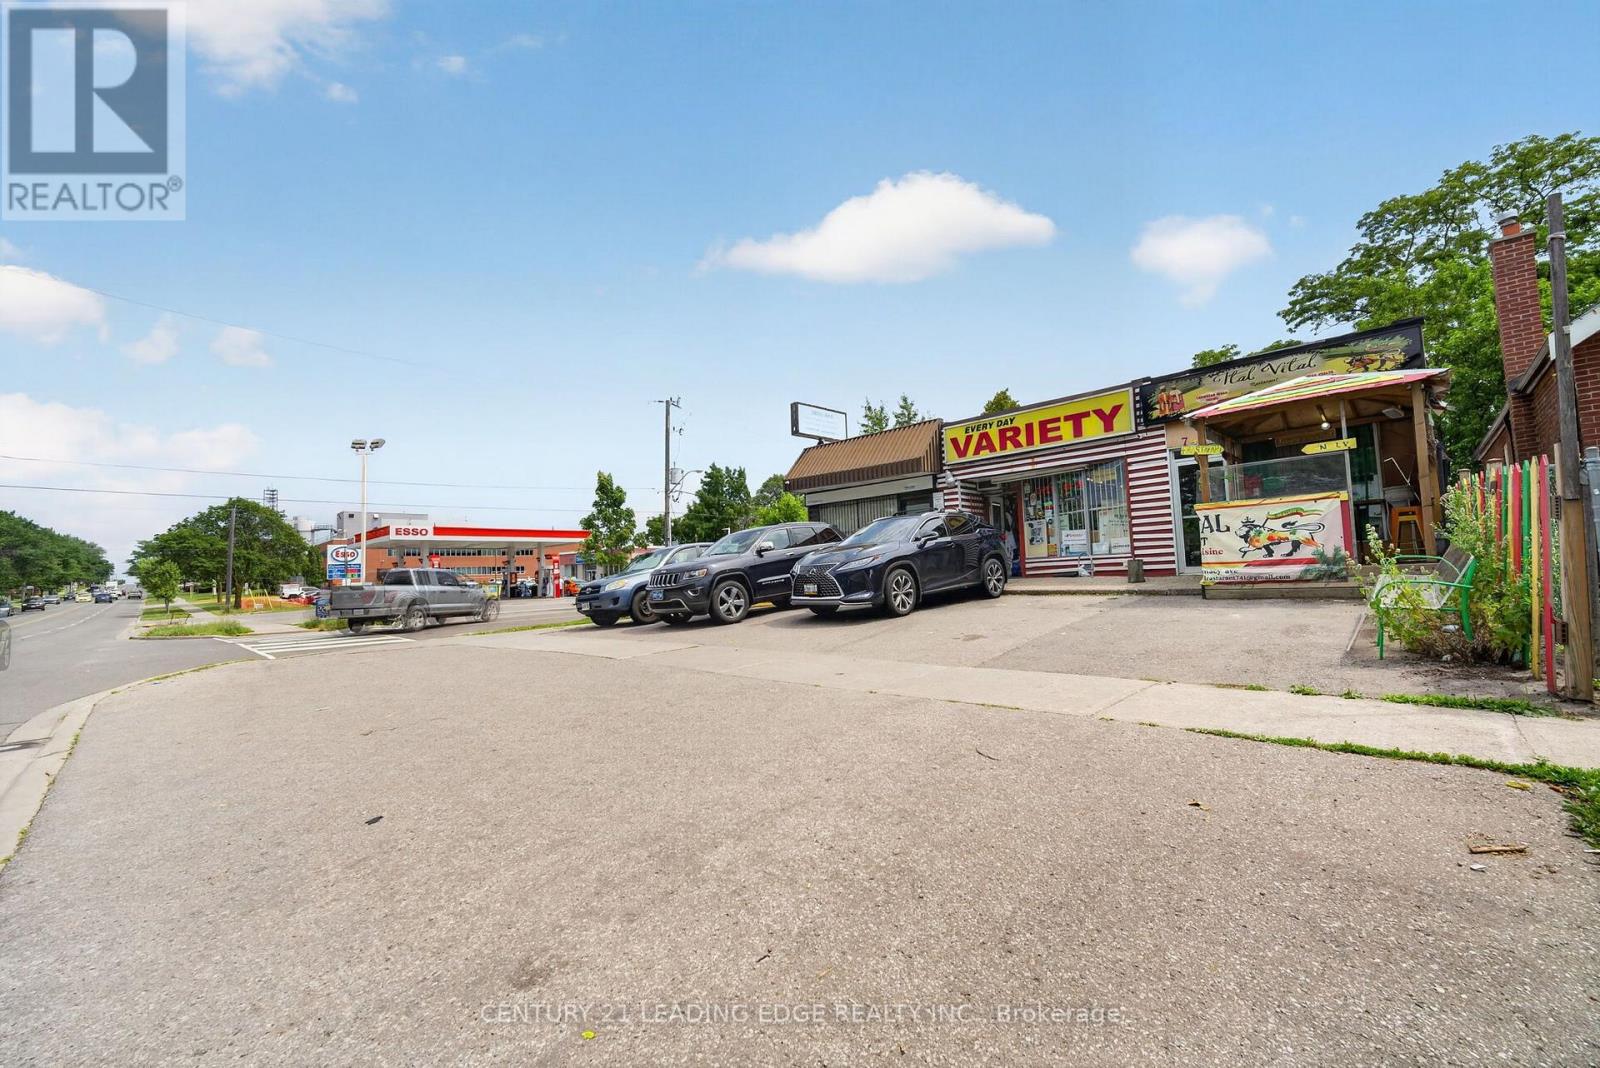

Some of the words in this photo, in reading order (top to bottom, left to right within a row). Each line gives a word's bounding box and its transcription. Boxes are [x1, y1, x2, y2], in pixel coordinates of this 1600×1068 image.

[950, 403, 1124, 459] VARIETY
[964, 421, 993, 434] EVERY
[996, 416, 1016, 429] DAY
[395, 527, 428, 536] ESSO
[1200, 513, 1231, 534] AL
